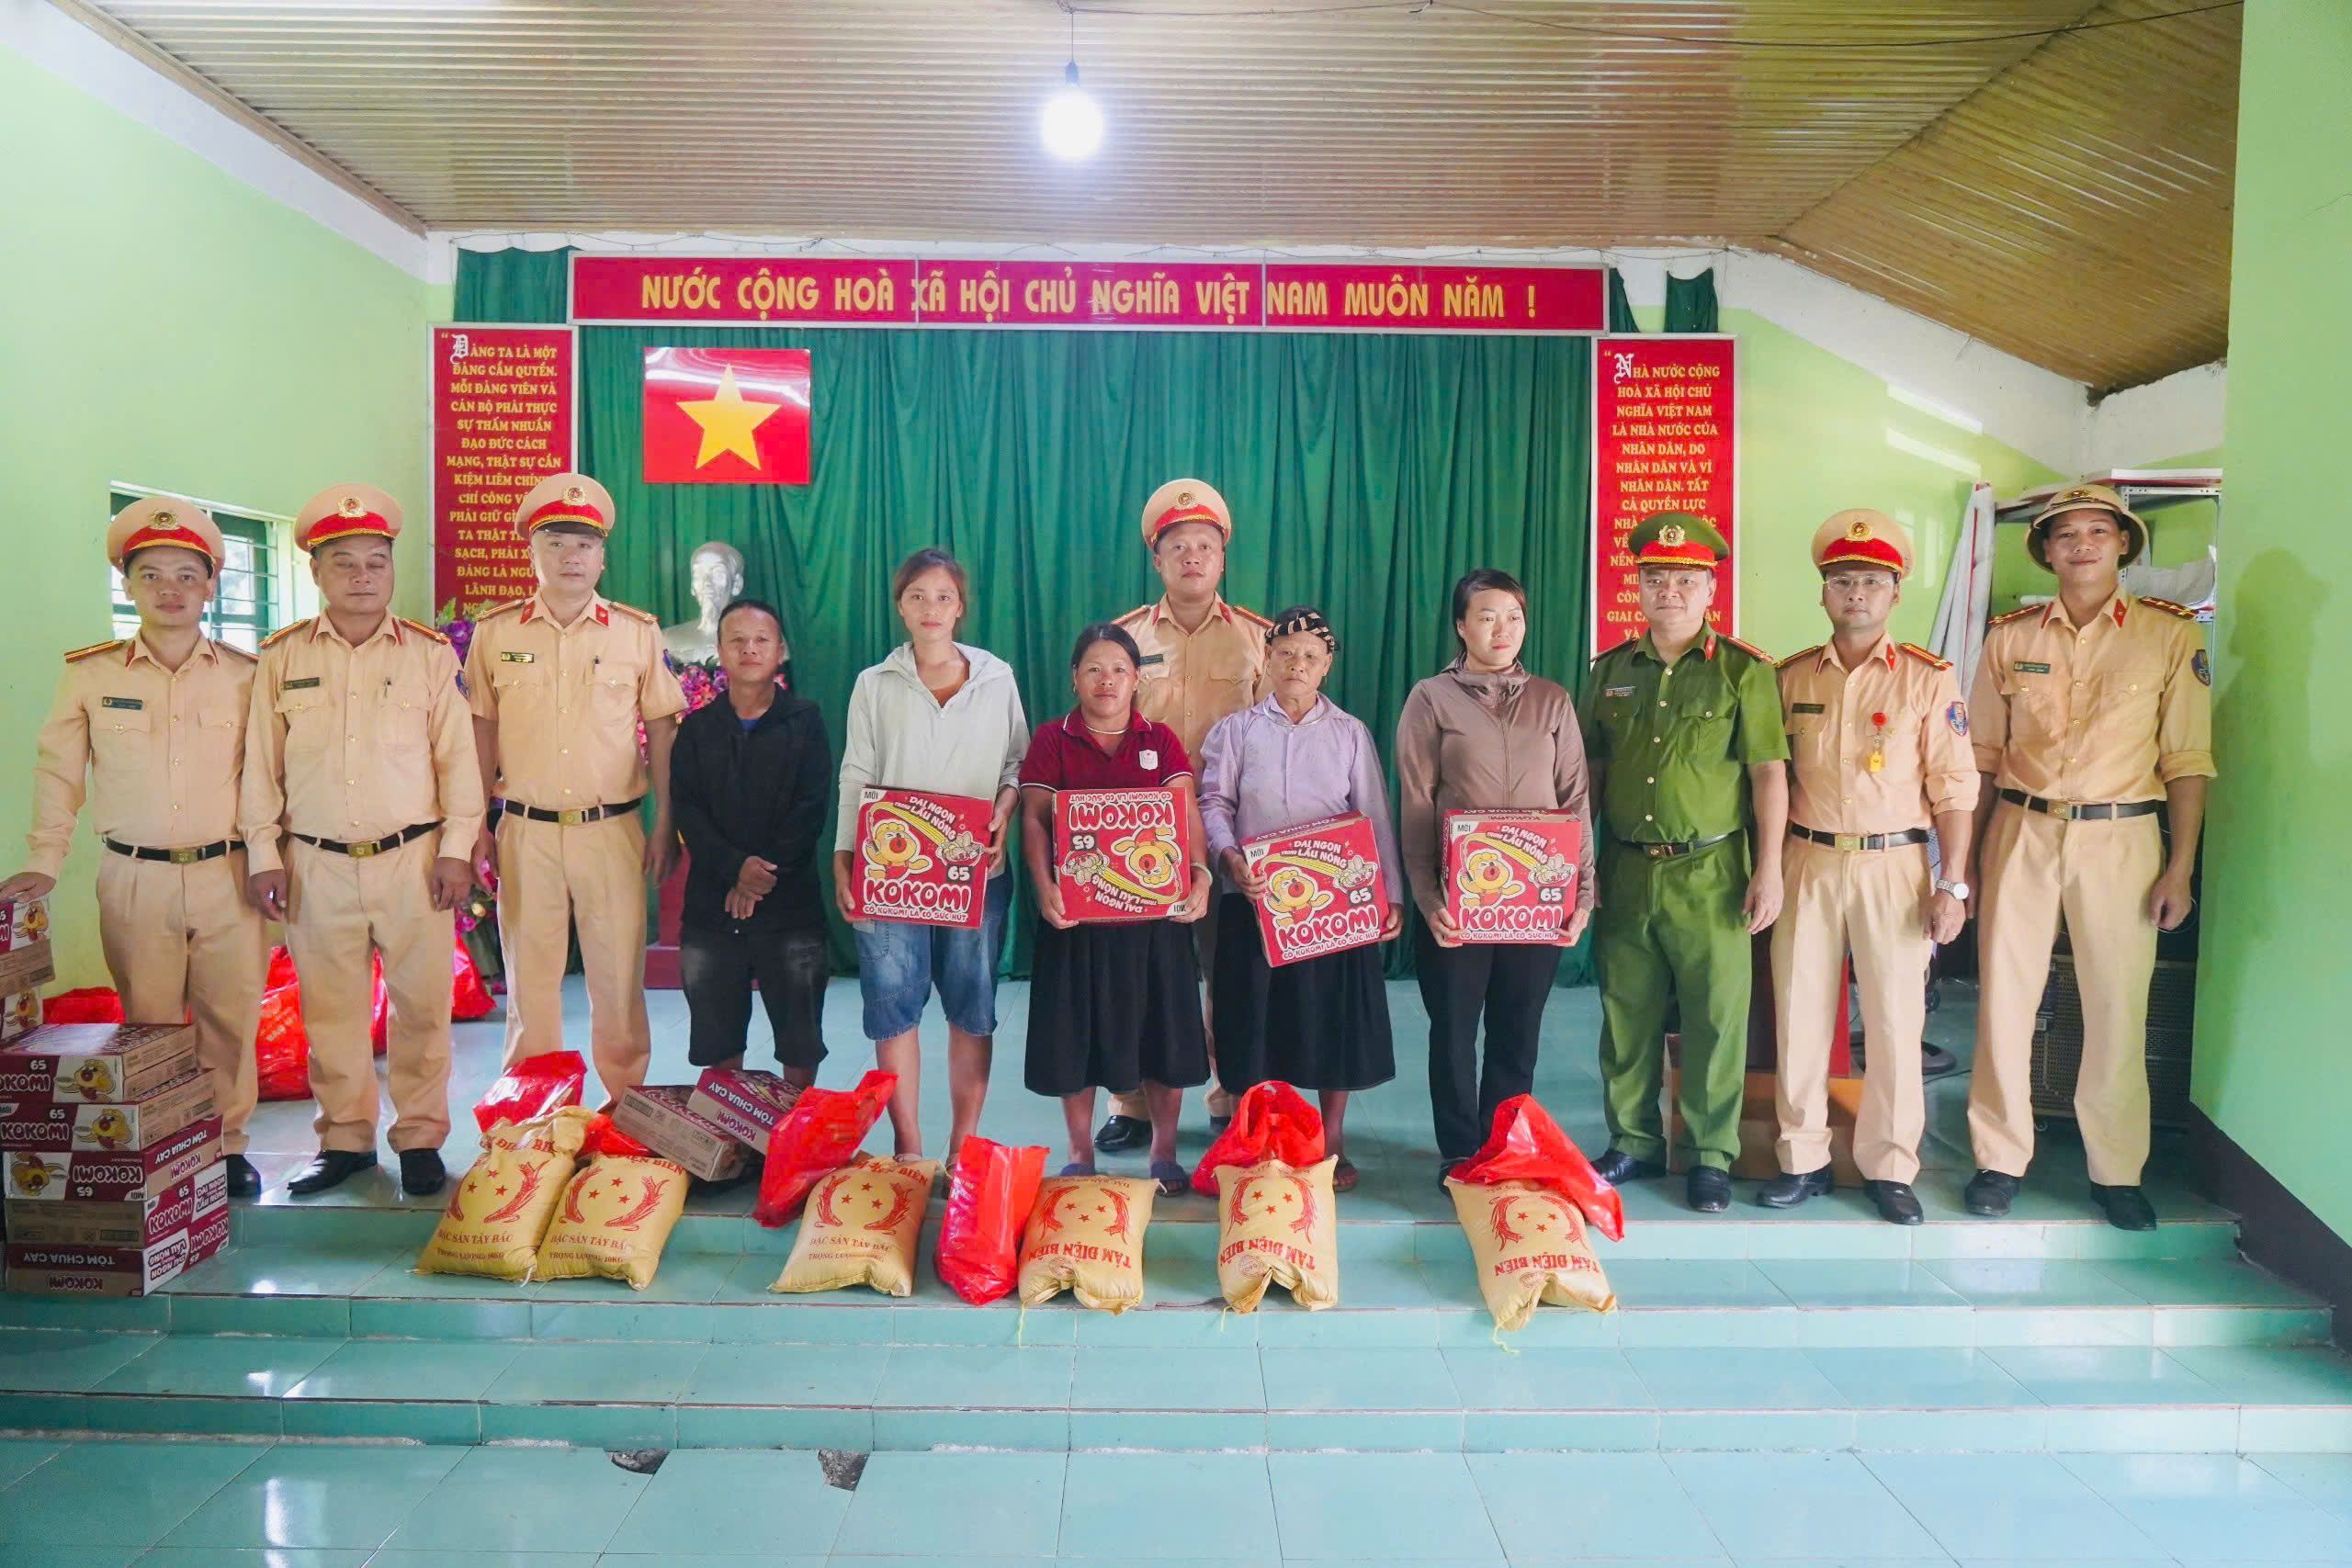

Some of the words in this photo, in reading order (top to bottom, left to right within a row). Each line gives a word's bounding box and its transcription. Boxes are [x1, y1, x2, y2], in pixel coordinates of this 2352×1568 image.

[642, 267, 721, 310] NƯỚC
[738, 267, 820, 321] CỘNG
[834, 268, 895, 311] HOÀ
[911, 270, 946, 311] XÃ
[960, 270, 1010, 323] HỘI
[1024, 266, 1076, 313] CHỦ
[1092, 272, 1179, 316] NGHĨA
[1195, 273, 1250, 325] VIỆT
[1267, 283, 1329, 316] NAM
[1344, 275, 1429, 318] MUÔN
[1443, 275, 1505, 318] NĂM
[498, 346, 514, 357] TA
[533, 345, 558, 360] MỘT
[452, 362, 486, 376] ĐẢNG
[1652, 363, 1685, 378] NƯỚC
[1688, 364, 1720, 379] CỘNG
[475, 379, 507, 394] ĐẢNG
[510, 382, 537, 395] VIÊN
[1617, 384, 1642, 397] HOÀ
[1645, 384, 1661, 398] XÃ
[1664, 384, 1685, 400] HỘI
[1687, 385, 1712, 398] CHỦ
[450, 398, 475, 412] CÁN
[478, 400, 493, 414] BỘ
[495, 400, 523, 413] PHẢI
[1617, 402, 1654, 417] NGHĨA
[1657, 403, 1683, 419] VIỆT
[1686, 405, 1712, 416] NAM
[1630, 422, 1655, 436] NHÀ
[1657, 422, 1690, 435] NƯỚC
[1693, 422, 1718, 435] CỦA
[461, 437, 486, 450] ĐẠO
[489, 435, 514, 449] ĐỨC
[516, 435, 547, 449] CÁCH
[1622, 441, 1656, 455] NHÂN
[1658, 441, 1686, 457] DÂN,
[1689, 444, 1706, 454] DO
[447, 456, 484, 468] MẠNG,
[1616, 459, 1649, 473] NHÂN
[1652, 459, 1677, 473] DÂN
[454, 473, 482, 487] KIỆM
[485, 474, 512, 486] LIÊM
[1620, 479, 1654, 492] NHÂN
[458, 491, 479, 504] CHÍ
[481, 491, 512, 504] CÔNG
[1683, 499, 1707, 513] LỰC
[449, 508, 477, 522] PHẢI
[458, 530, 474, 540] TA
[477, 528, 508, 543] THẬT
[455, 547, 489, 561] SẠCH,
[492, 546, 517, 559] PHẢI
[465, 582, 496, 595] LÃNH
[1607, 612, 1632, 623] GIAI
[1128, 792, 1159, 800] KOKOMI
[929, 802, 956, 824] NGON
[1069, 801, 1175, 830] KOKOMI
[1072, 834, 1095, 850] 65
[1255, 831, 1278, 841] CAY
[1519, 830, 1547, 848] NGON
[1313, 840, 1341, 854] NGON
[947, 866, 971, 881] 65
[864, 877, 971, 913] KOKOMI
[1094, 892, 1123, 909] NGON
[1349, 886, 1372, 904] 65
[1540, 887, 1562, 902] 65
[876, 907, 907, 916] KOKOMI
[1459, 906, 1564, 931] KOKOMI
[1276, 905, 1379, 950] KOKOMI
[1295, 944, 1325, 956] KOKOMI
[29, 1059, 47, 1070] 65
[708, 1081, 728, 1097] CAY
[728, 1092, 752, 1111] CHUA
[49, 1109, 65, 1120] 65
[752, 1108, 775, 1125] TÔM
[1, 1122, 70, 1141] KOKOMI
[715, 1108, 757, 1143] KOKOMI
[192, 1129, 208, 1145] TÔM
[170, 1139, 192, 1156] CHUA
[154, 1149, 170, 1165] CAY
[170, 1153, 201, 1180] KOKOMI
[73, 1165, 144, 1184] KOKOMI
[76, 1186, 93, 1196] 65
[178, 1184, 189, 1198] 65
[148, 1197, 193, 1235] KOKOMI
[190, 1217, 229, 1253] KOKOMI
[23, 1252, 48, 1263] CAY
[188, 1253, 199, 1266] 65
[1028, 1243, 1059, 1261] BIÊN
[1063, 1241, 1100, 1263] ĐIỆN
[50, 1254, 85, 1266] CHUA
[87, 1254, 115, 1266] TÔM
[49, 1276, 103, 1291] KOKOMI
